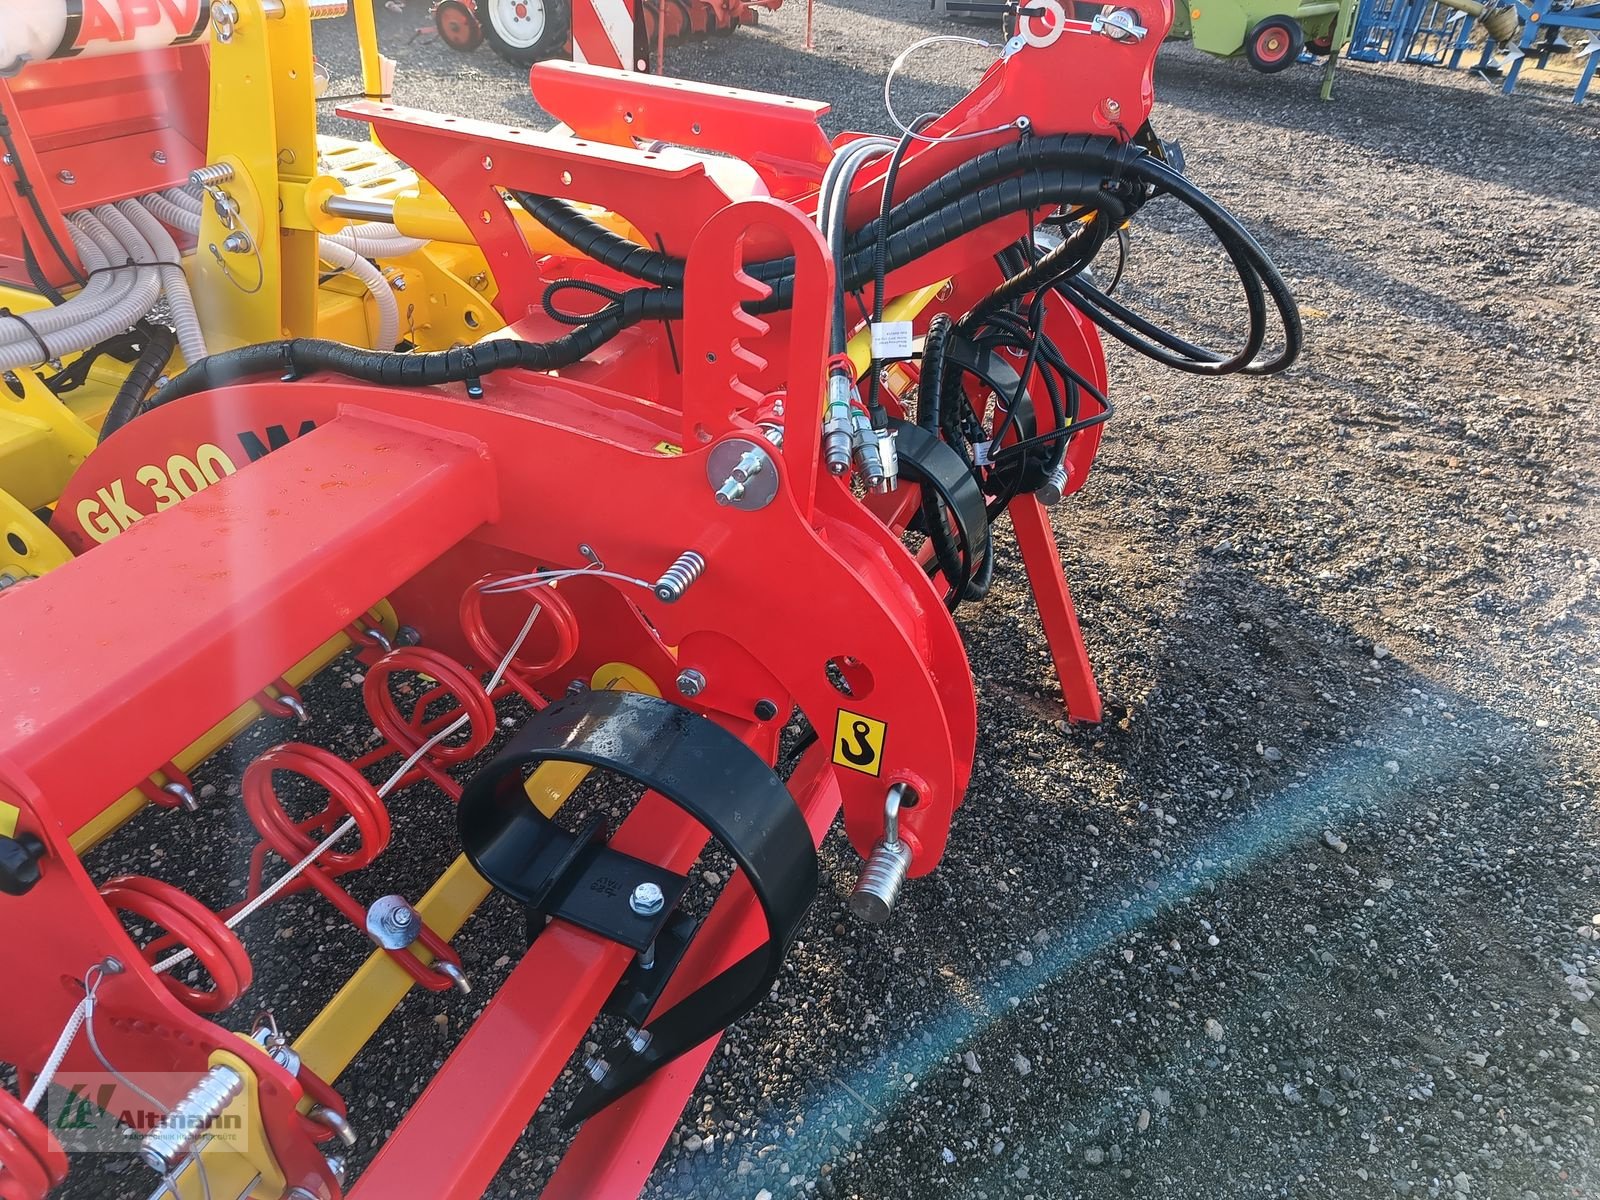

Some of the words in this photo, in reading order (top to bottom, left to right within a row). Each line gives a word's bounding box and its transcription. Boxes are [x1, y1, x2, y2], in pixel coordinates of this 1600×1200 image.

[73, 0, 200, 47] APV
[76, 478, 145, 544] GK
[135, 443, 237, 513] 300
